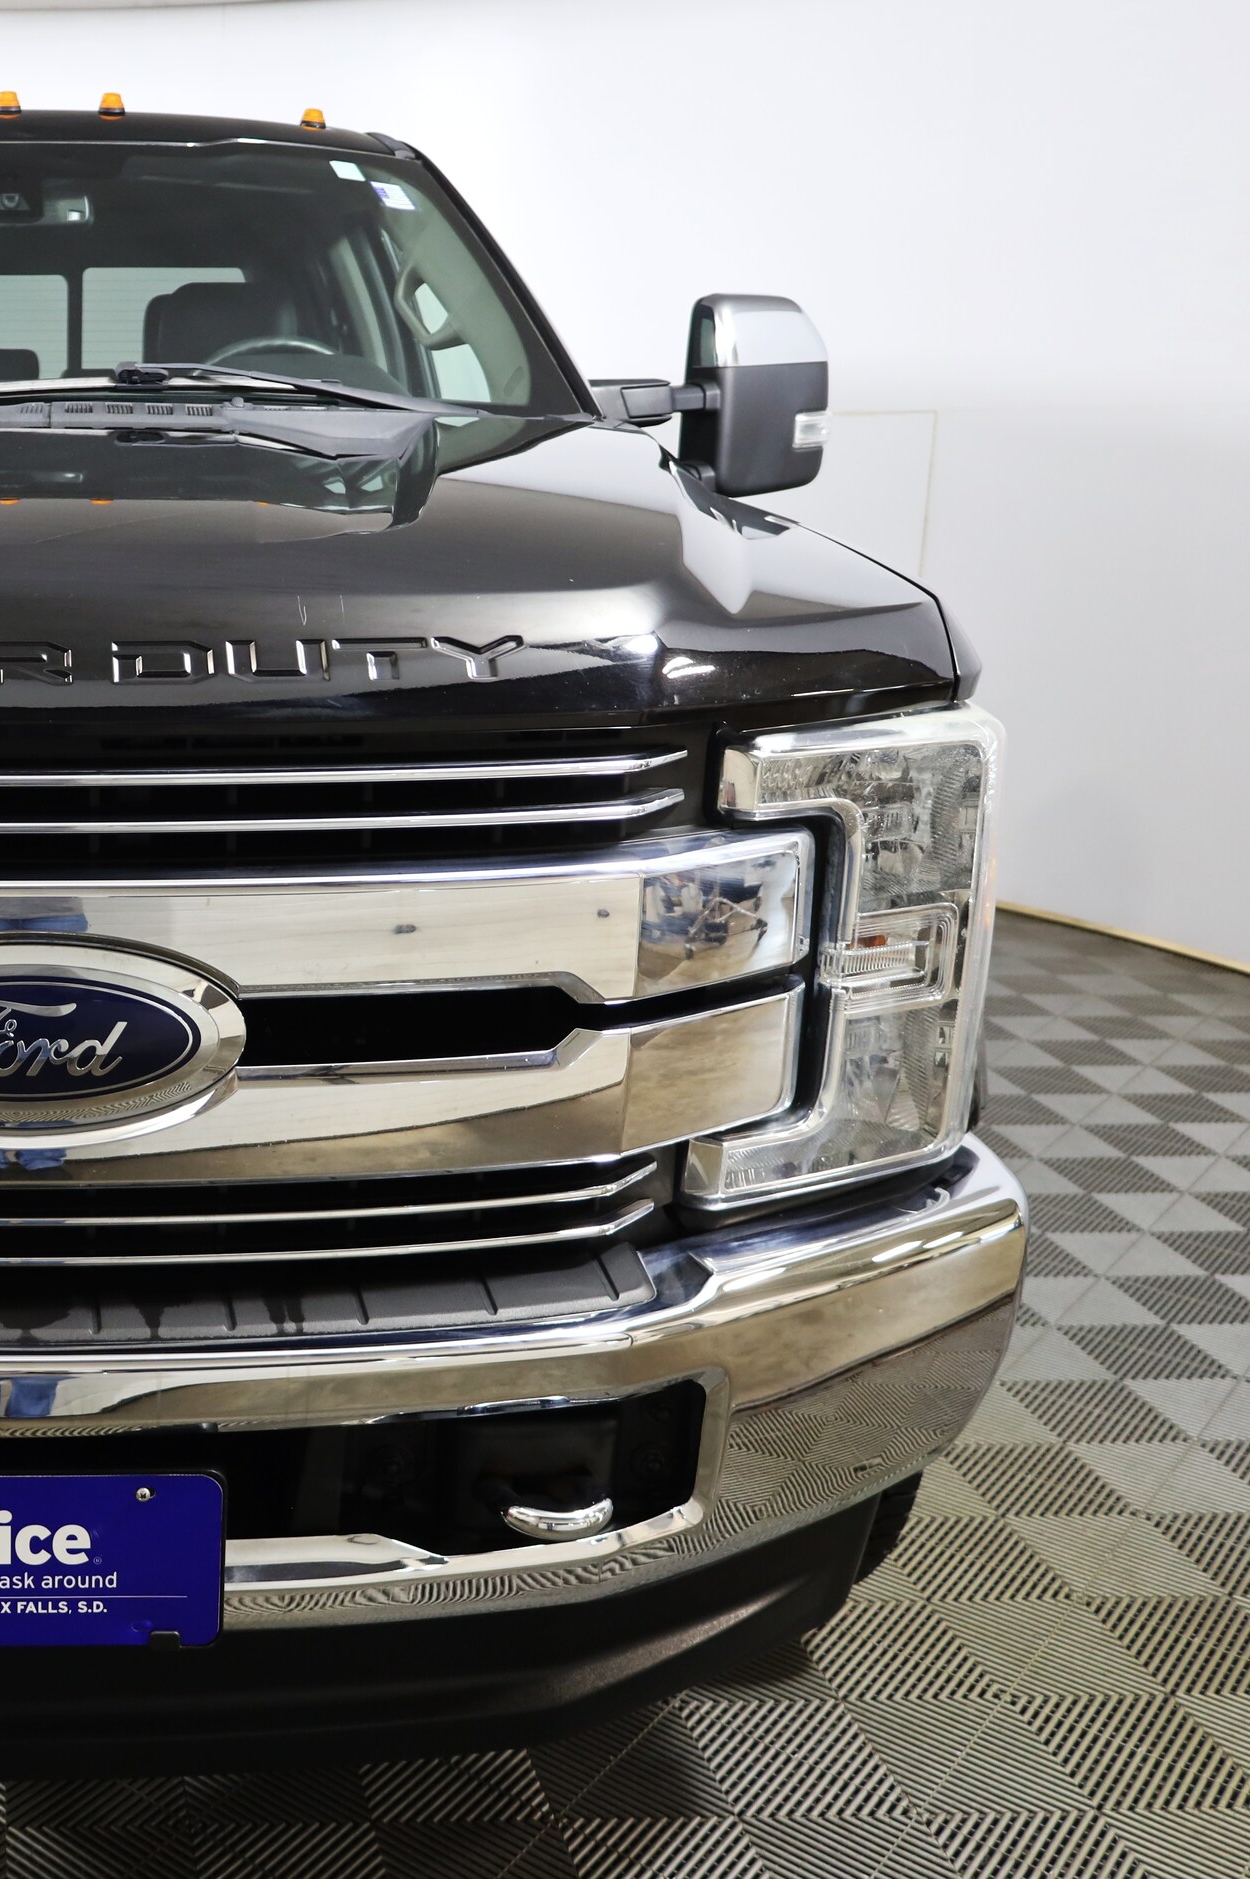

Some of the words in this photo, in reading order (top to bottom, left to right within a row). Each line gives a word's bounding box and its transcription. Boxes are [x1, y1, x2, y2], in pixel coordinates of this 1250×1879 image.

[111, 634, 526, 685] DUTY
[42, 1571, 117, 1589] around
[16, 1601, 73, 1615] FALLS,
[77, 1600, 108, 1614] S.D.
